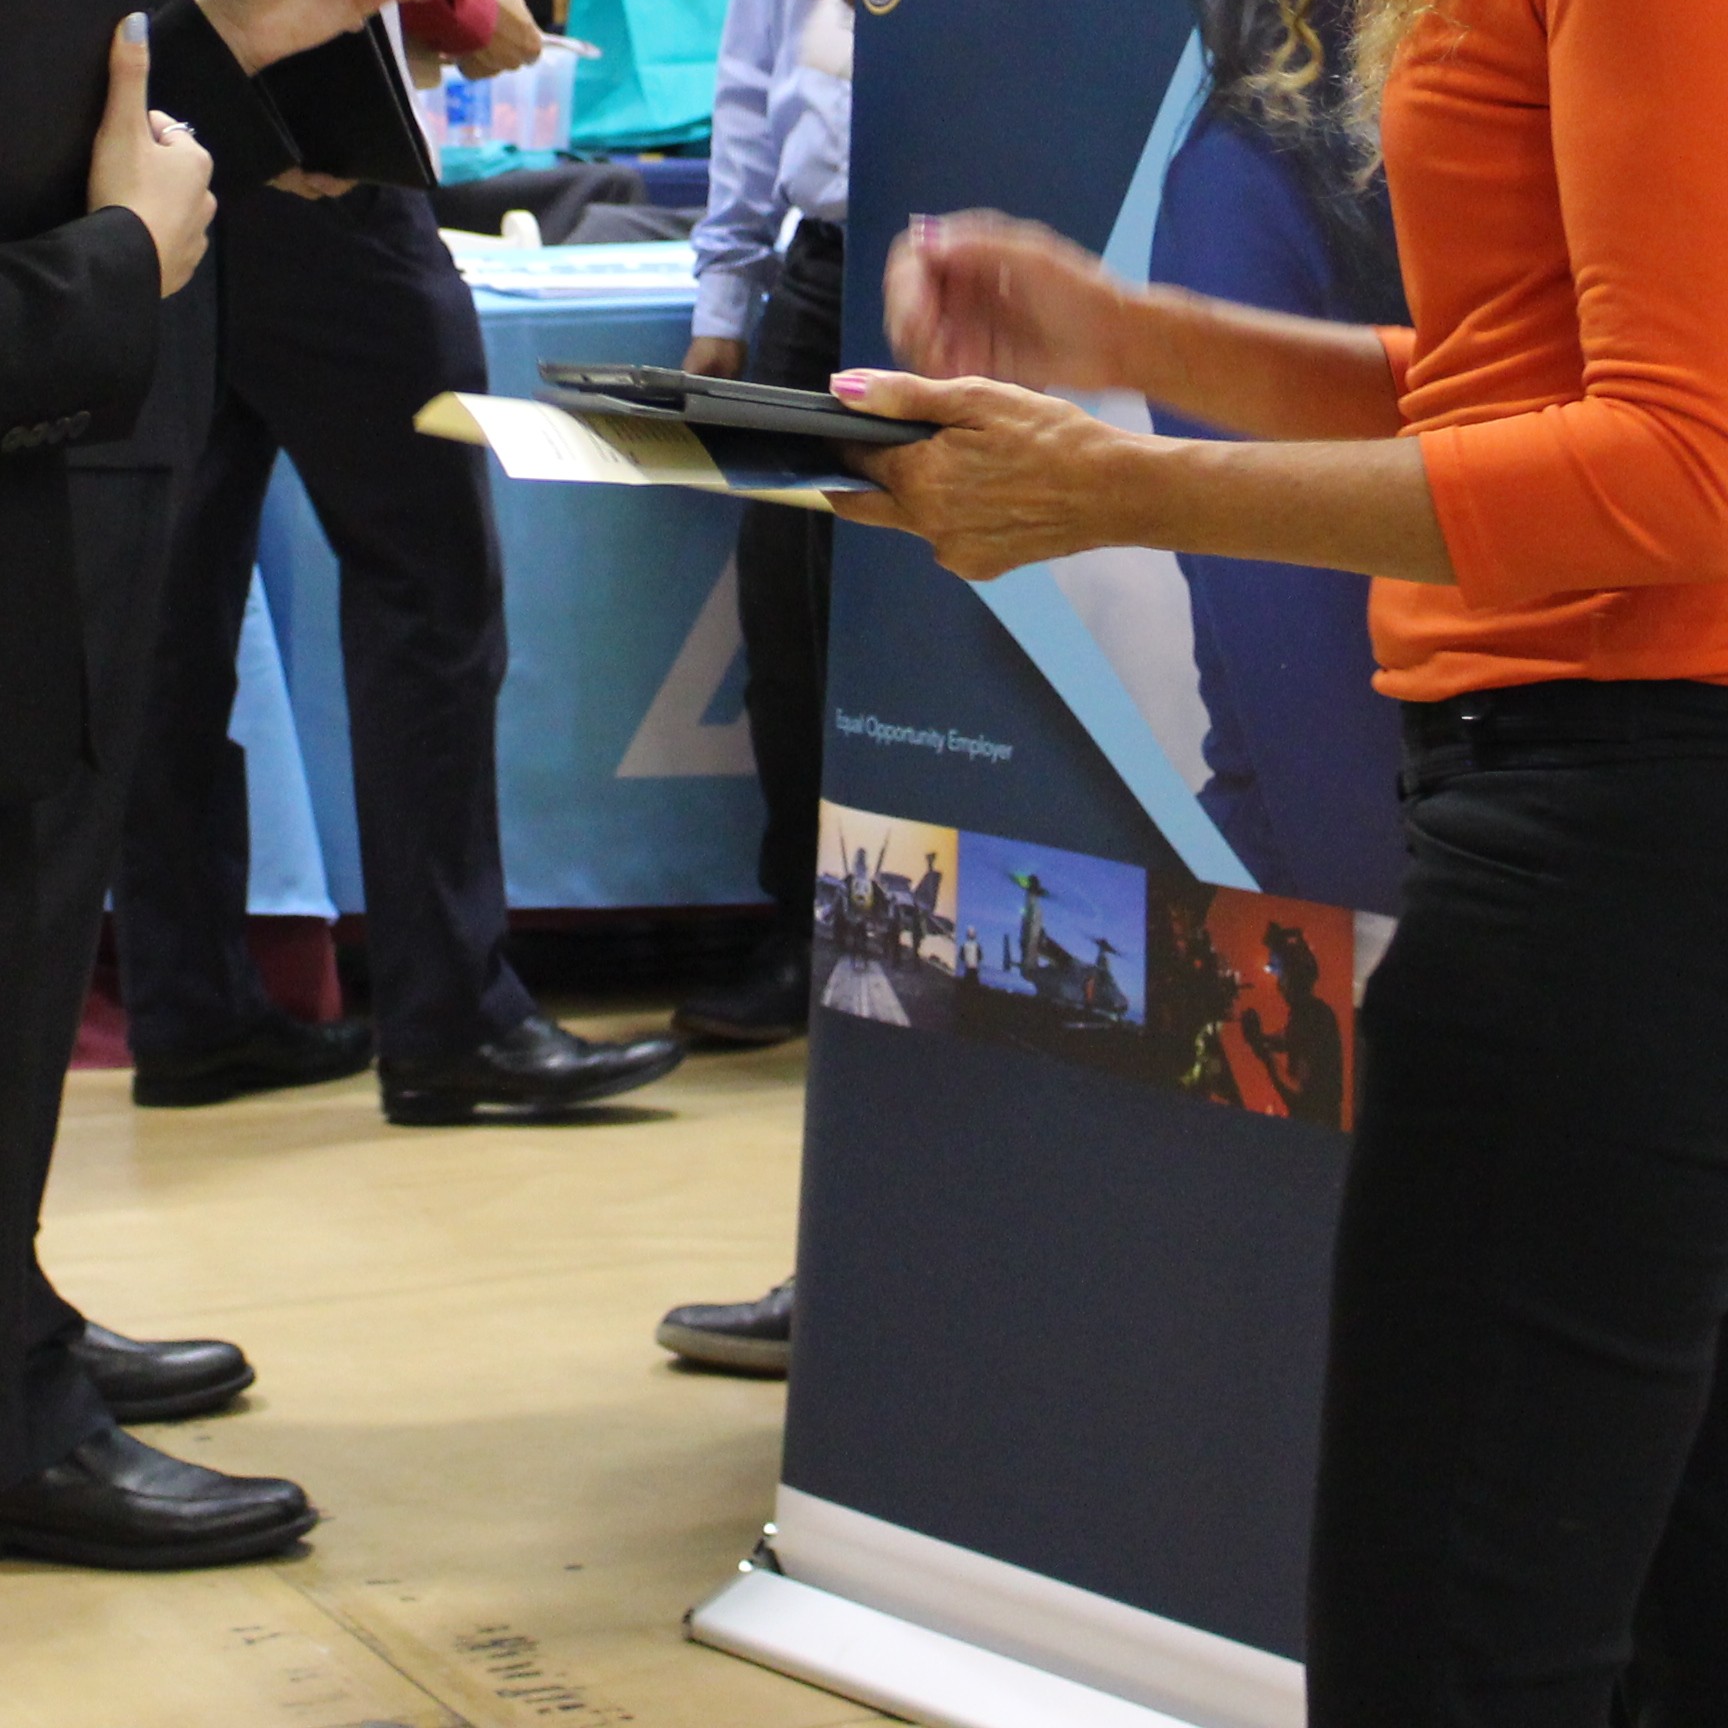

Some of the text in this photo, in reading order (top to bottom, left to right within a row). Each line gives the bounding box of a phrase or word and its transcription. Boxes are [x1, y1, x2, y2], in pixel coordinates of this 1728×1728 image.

[835, 707, 1014, 764] Equal Opportunity Employer
